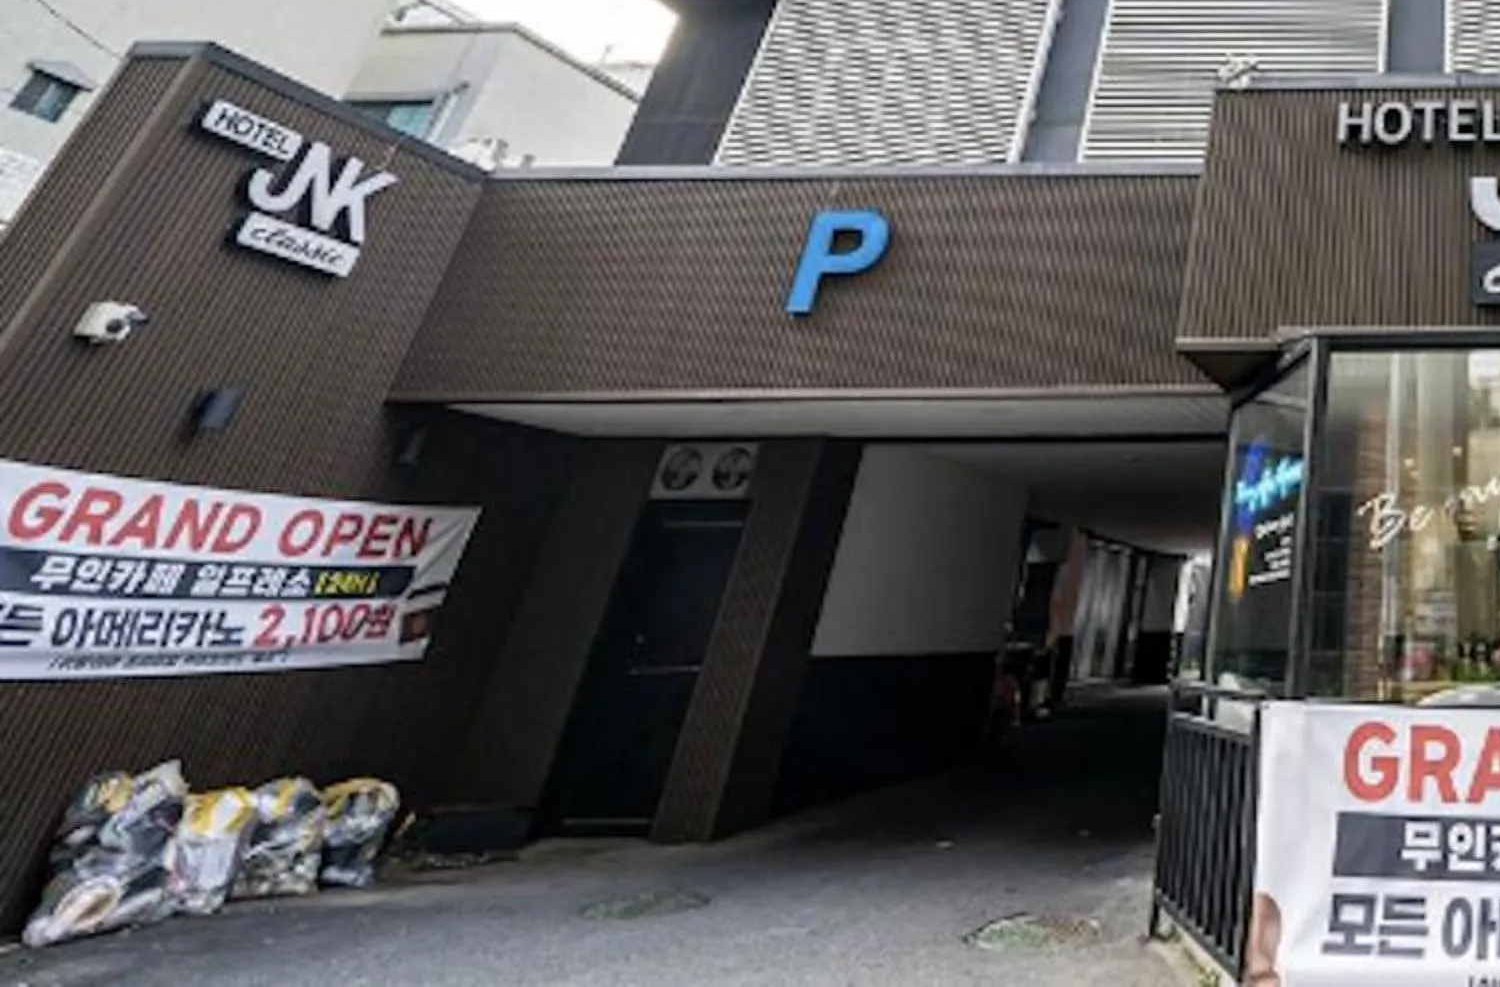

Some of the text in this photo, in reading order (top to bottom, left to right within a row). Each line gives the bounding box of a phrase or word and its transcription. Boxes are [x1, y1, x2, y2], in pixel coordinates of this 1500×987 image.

[213, 107, 292, 156] HOTEL
[249, 141, 399, 243] JNK
[250, 224, 346, 265] classic
[783, 207, 890, 314] P
[7, 481, 433, 559] GRAND OPEN
[30, 554, 186, 596] 무인카페
[190, 563, 313, 598] 일프레소
[0, 602, 398, 649] 든 아메리카노 2,100원
[1321, 892, 1430, 959] 모든
